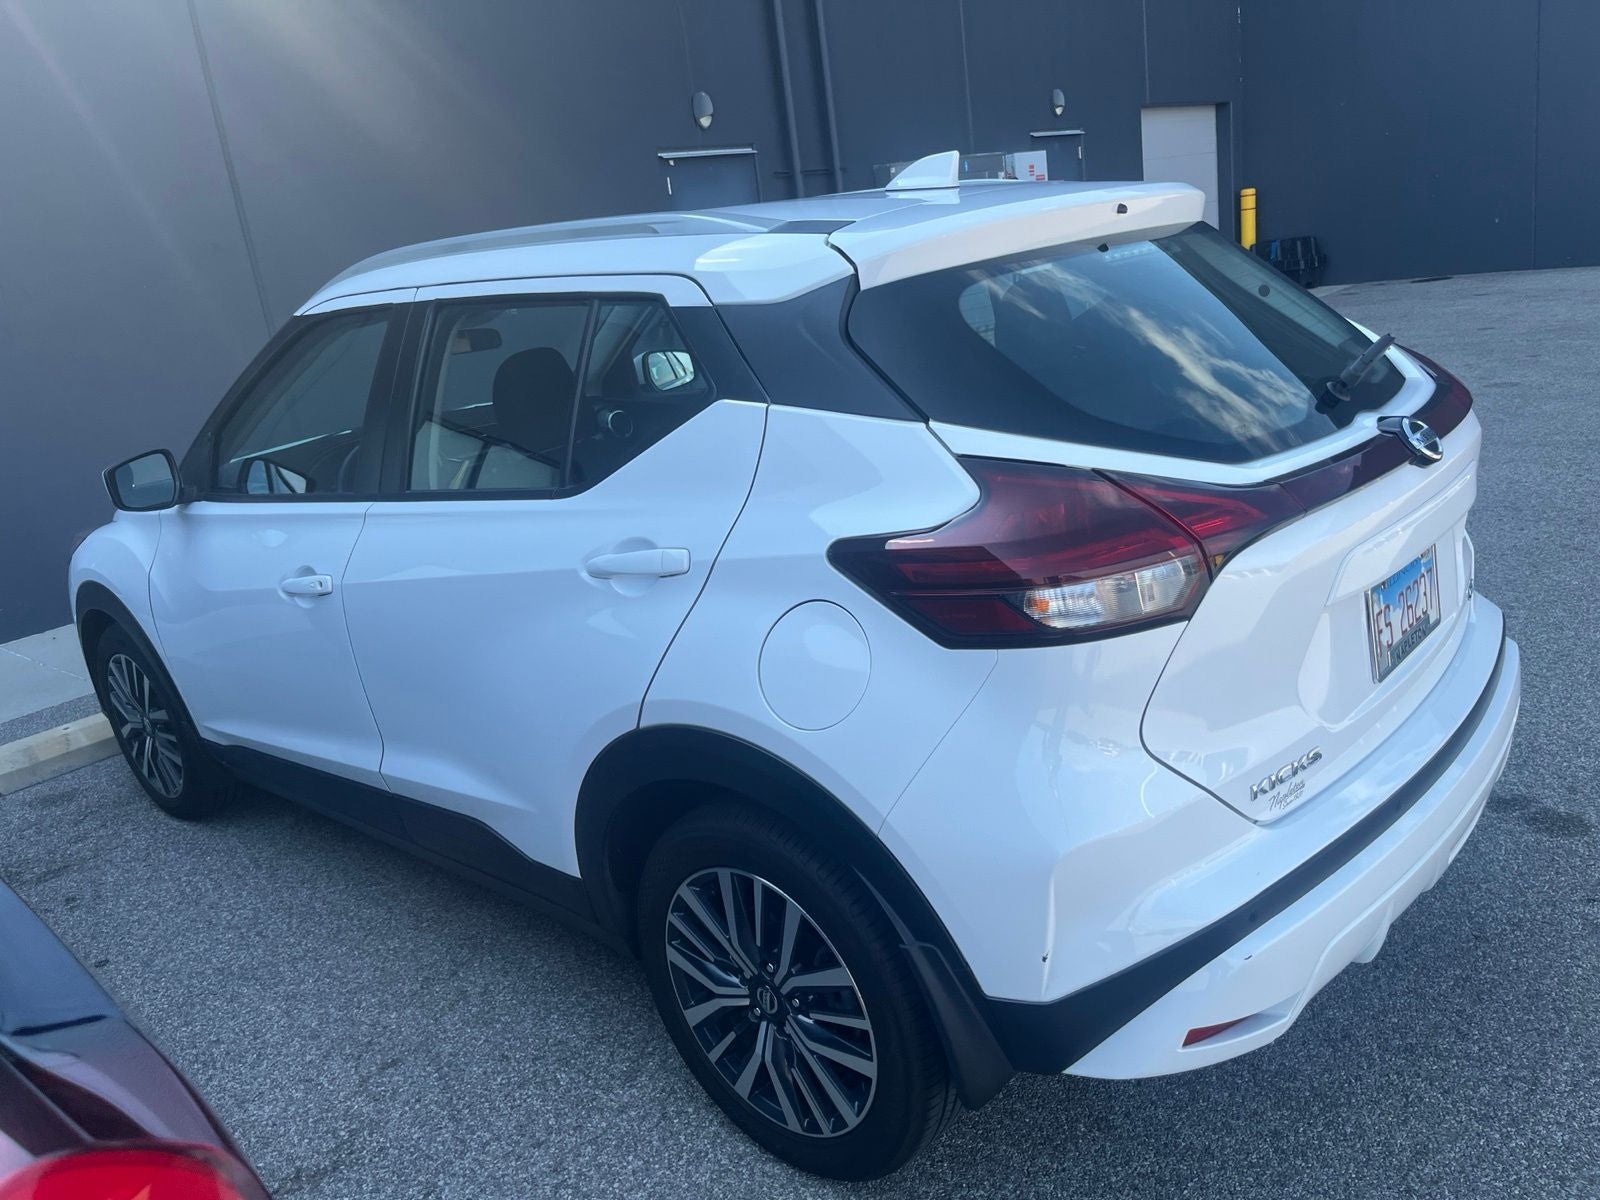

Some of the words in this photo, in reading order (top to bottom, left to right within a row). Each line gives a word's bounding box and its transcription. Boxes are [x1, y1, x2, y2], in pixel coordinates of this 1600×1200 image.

[1375, 604, 1394, 658] FS
[1397, 566, 1434, 635] 26237
[1395, 626, 1427, 662] NAPLETON
[1249, 745, 1323, 801] KICKS
